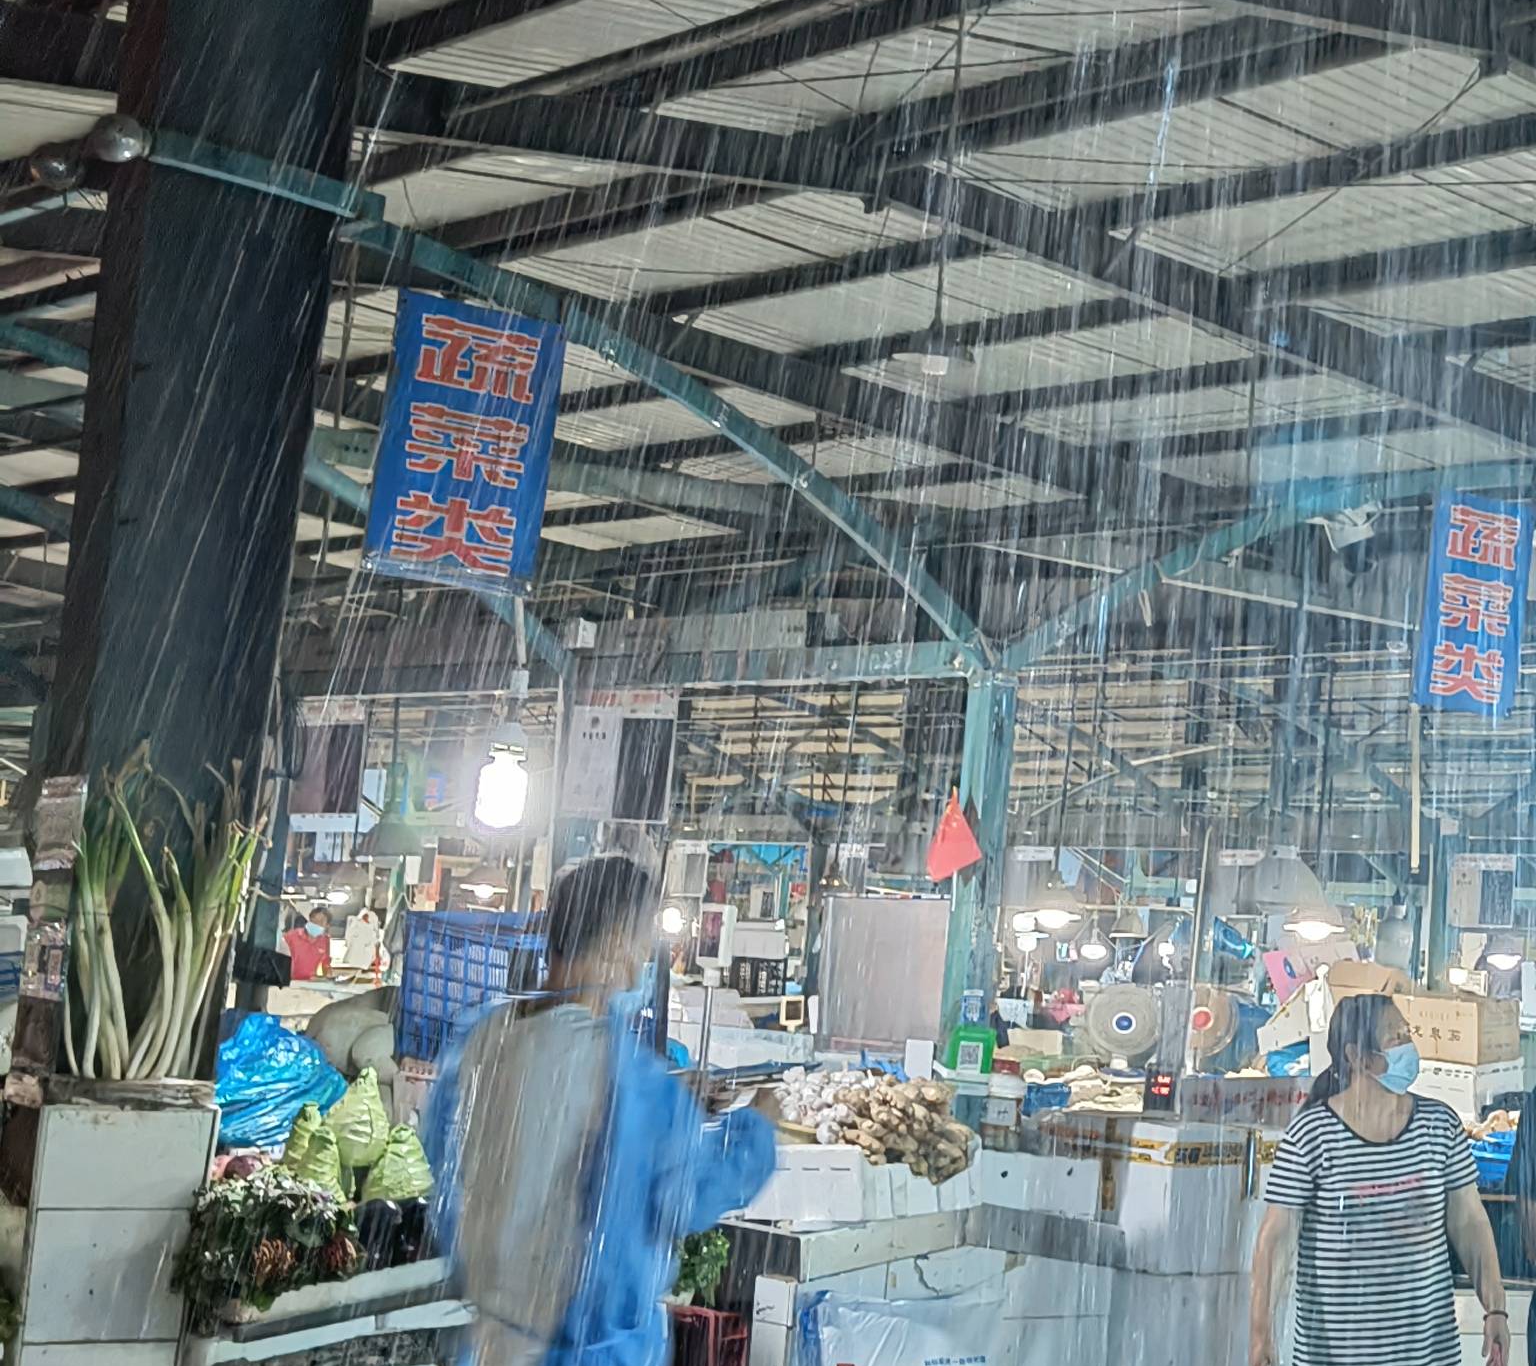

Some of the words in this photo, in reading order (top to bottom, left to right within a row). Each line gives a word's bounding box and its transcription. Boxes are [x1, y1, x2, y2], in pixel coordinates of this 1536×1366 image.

[389, 313, 543, 579] 蔬菜类
[1429, 503, 1521, 704] 蔬菜类
